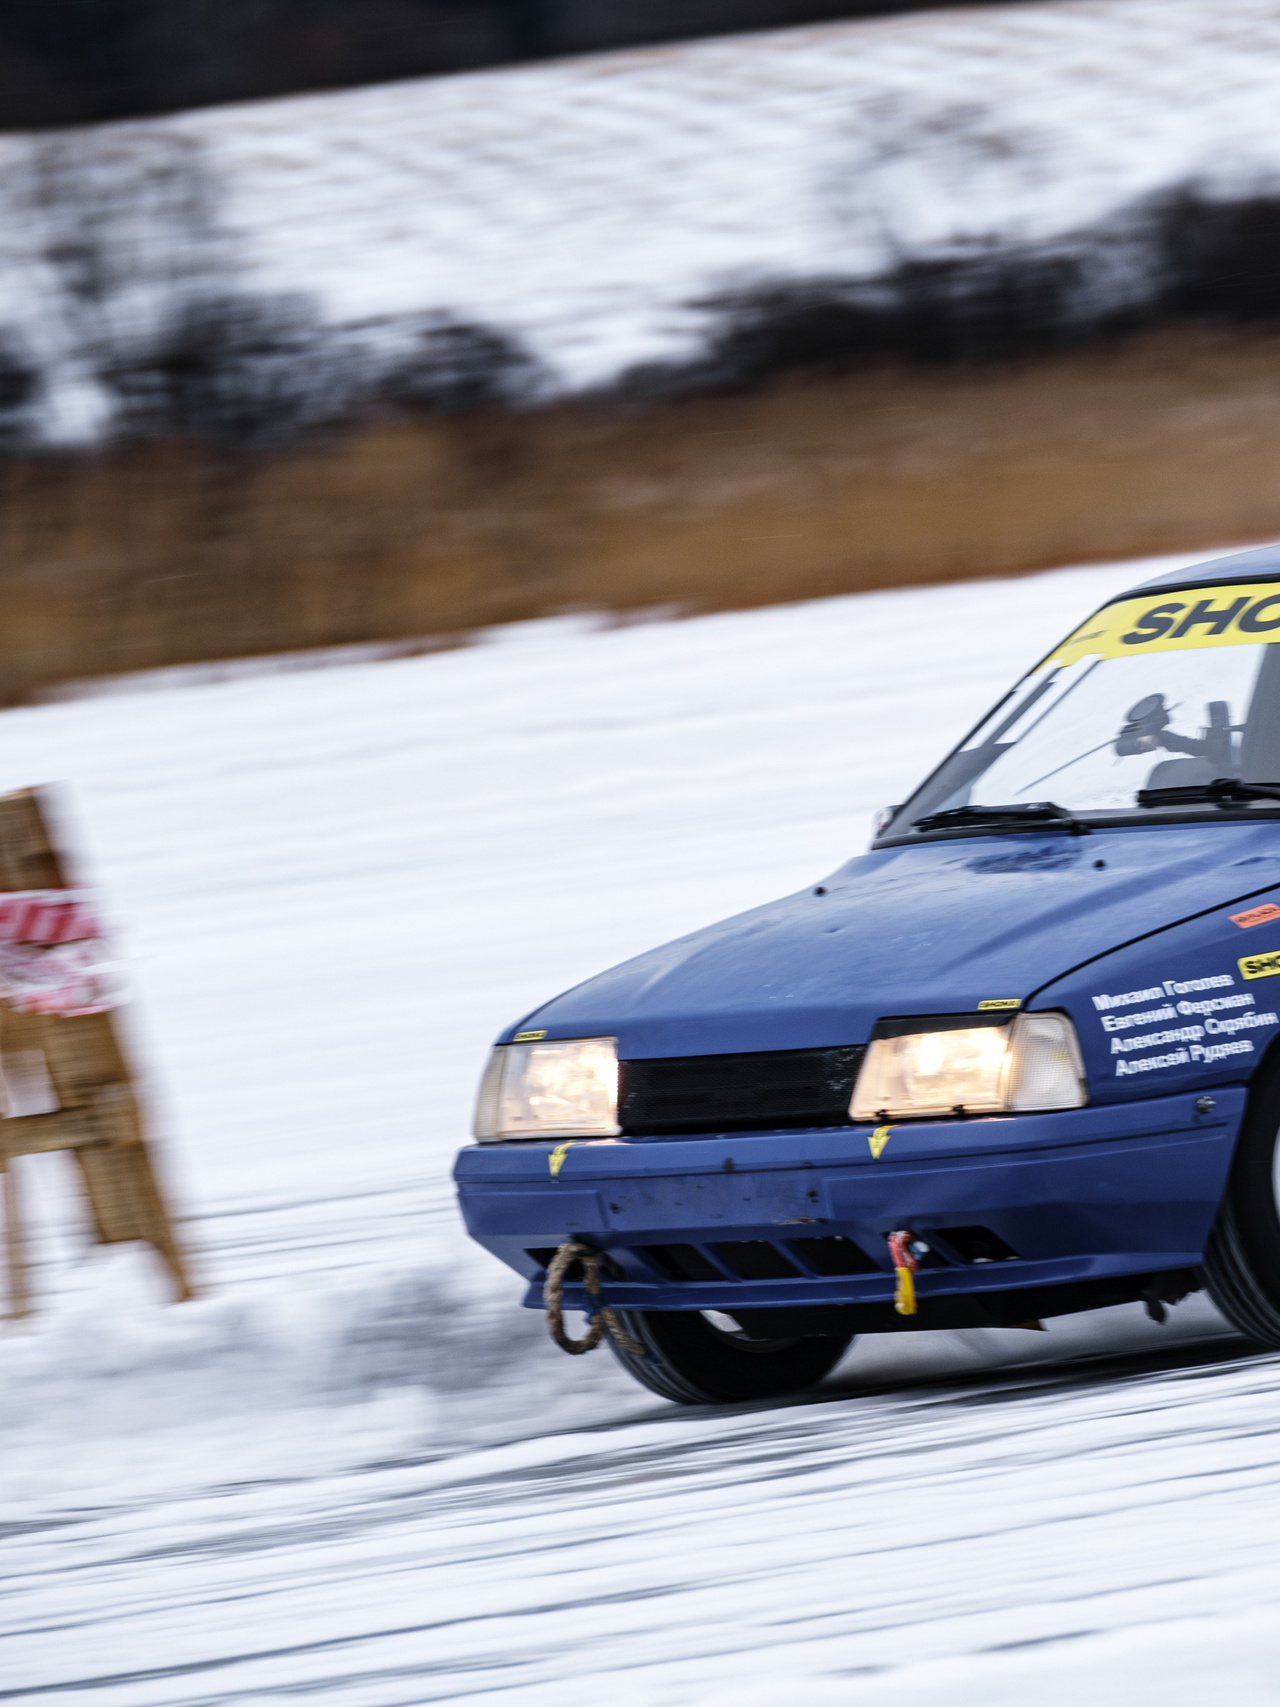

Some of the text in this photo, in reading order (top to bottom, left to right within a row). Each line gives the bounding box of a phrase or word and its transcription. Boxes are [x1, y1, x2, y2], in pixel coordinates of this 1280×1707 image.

[1091, 986, 1167, 1011] Михаил
[1100, 1003, 1178, 1032] Евгений
[1110, 1011, 1279, 1054] Александр Скрябин
[1115, 1046, 1191, 1076] Алексей
